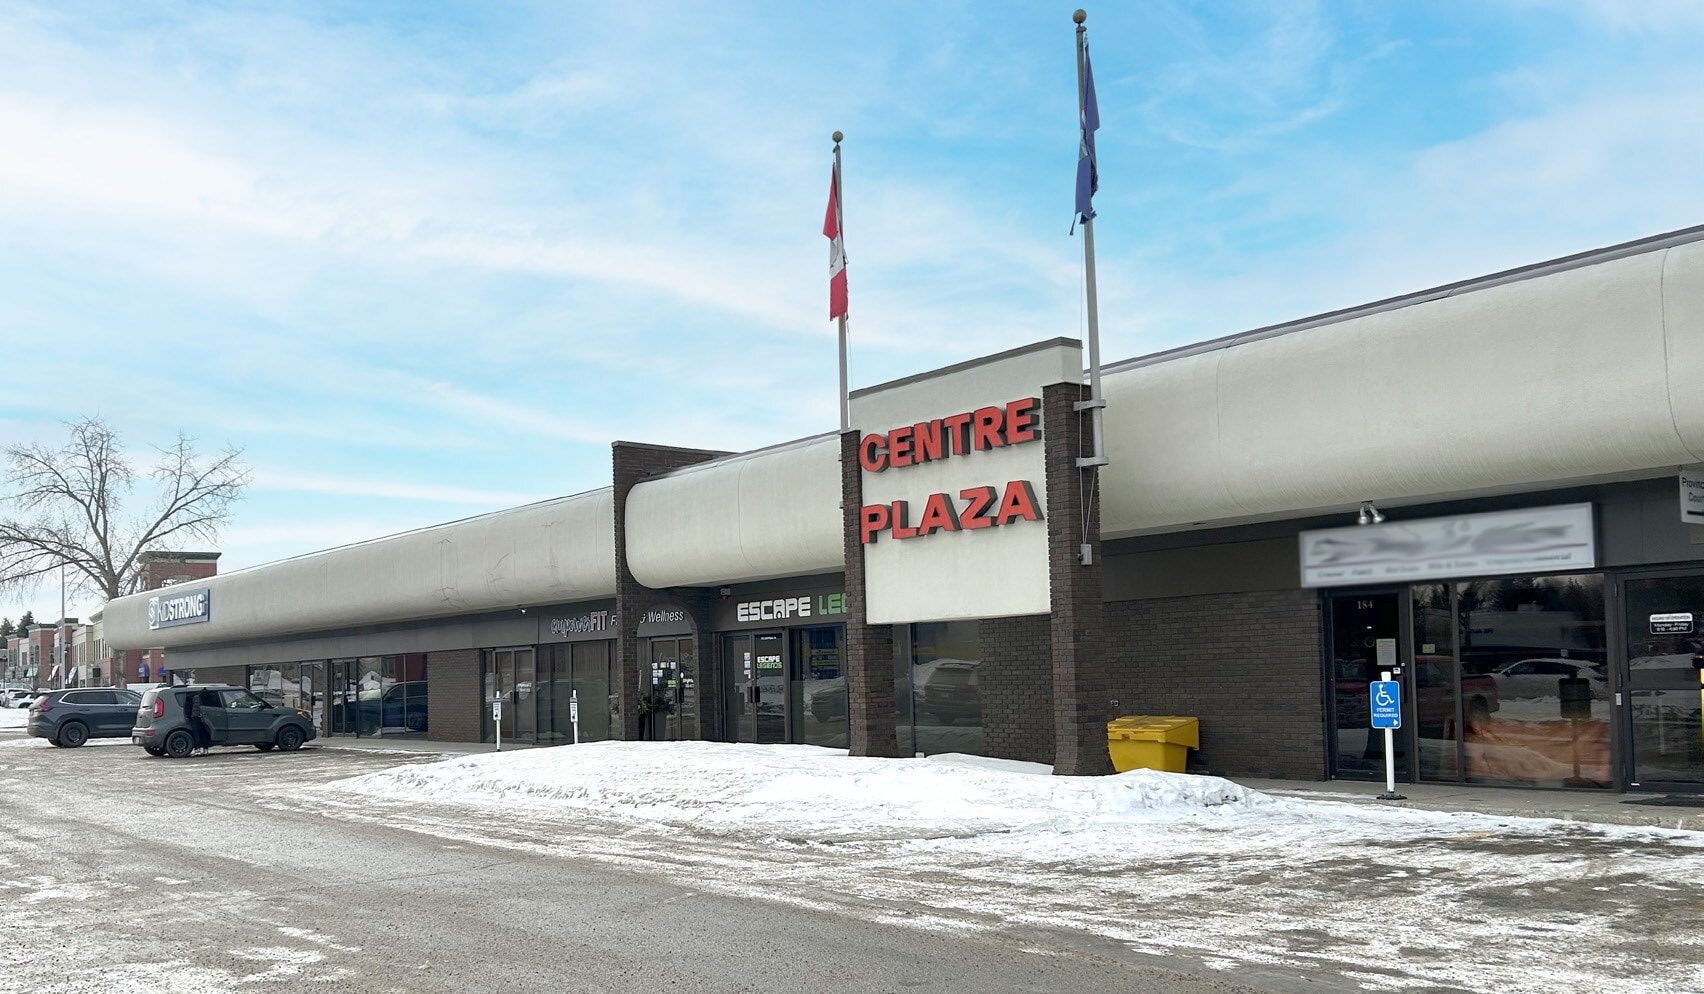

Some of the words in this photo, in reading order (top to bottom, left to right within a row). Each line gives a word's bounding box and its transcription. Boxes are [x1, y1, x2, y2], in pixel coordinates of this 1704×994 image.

[859, 397, 1041, 473] CENTRE
[861, 480, 1045, 544] PLAZA
[158, 594, 206, 622] KIDSTRONG
[648, 610, 684, 623] Wellness
[737, 596, 811, 622] ESCAPE
[1357, 600, 1374, 610] 184
[757, 655, 781, 663] ESCAPE
